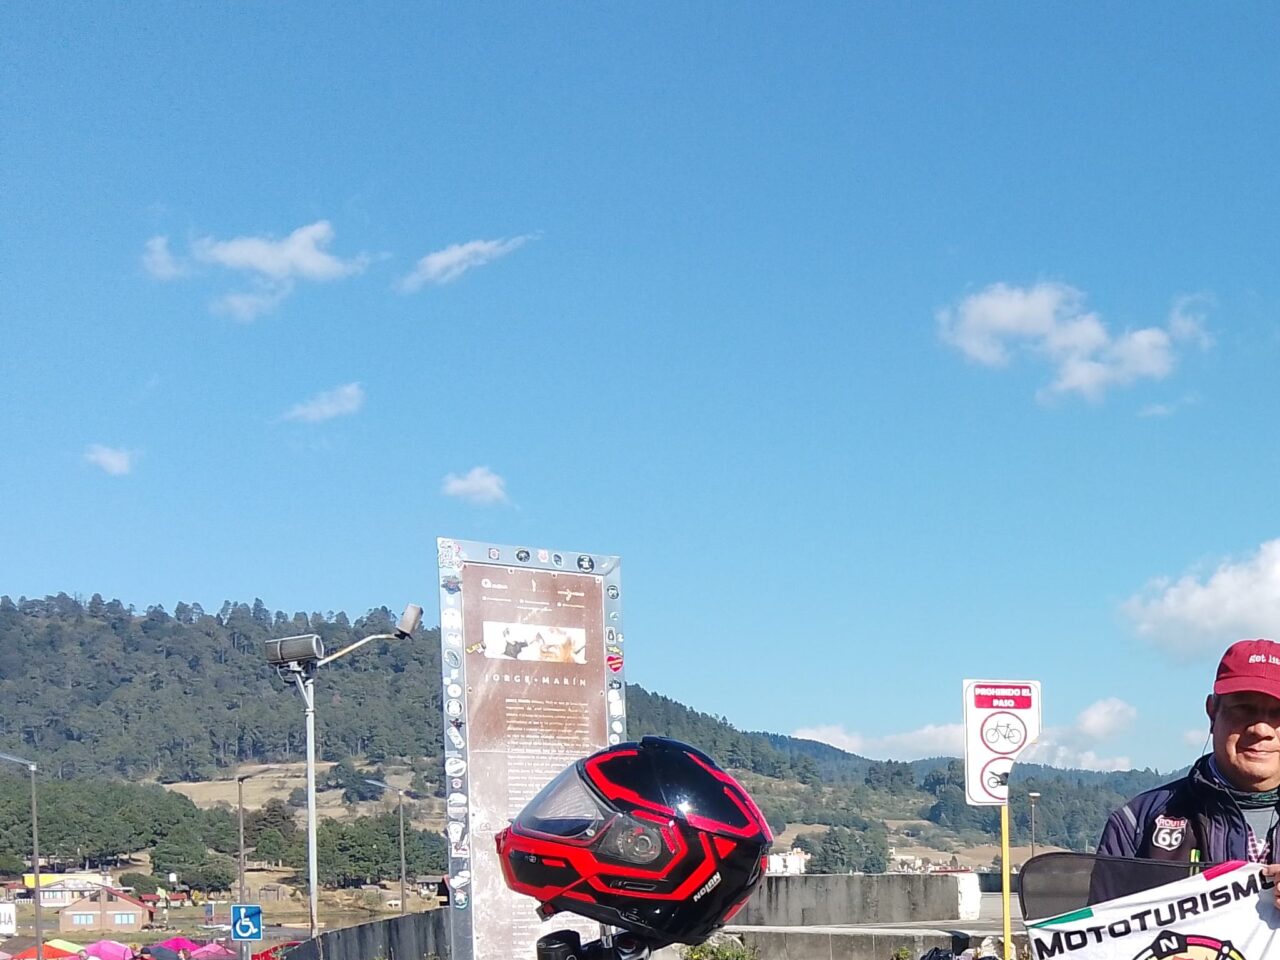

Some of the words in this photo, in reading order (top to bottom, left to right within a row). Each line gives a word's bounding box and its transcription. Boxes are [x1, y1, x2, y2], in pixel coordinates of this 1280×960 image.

[1248, 653, 1267, 664] got
[484, 674, 531, 684] JORGE
[541, 675, 587, 687] MARÍN
[992, 699, 1015, 707] PASO
[1158, 819, 1185, 828] ROUTE
[1158, 829, 1182, 846] 66
[693, 871, 722, 903] NOLAN
[1159, 935, 1178, 953] N
